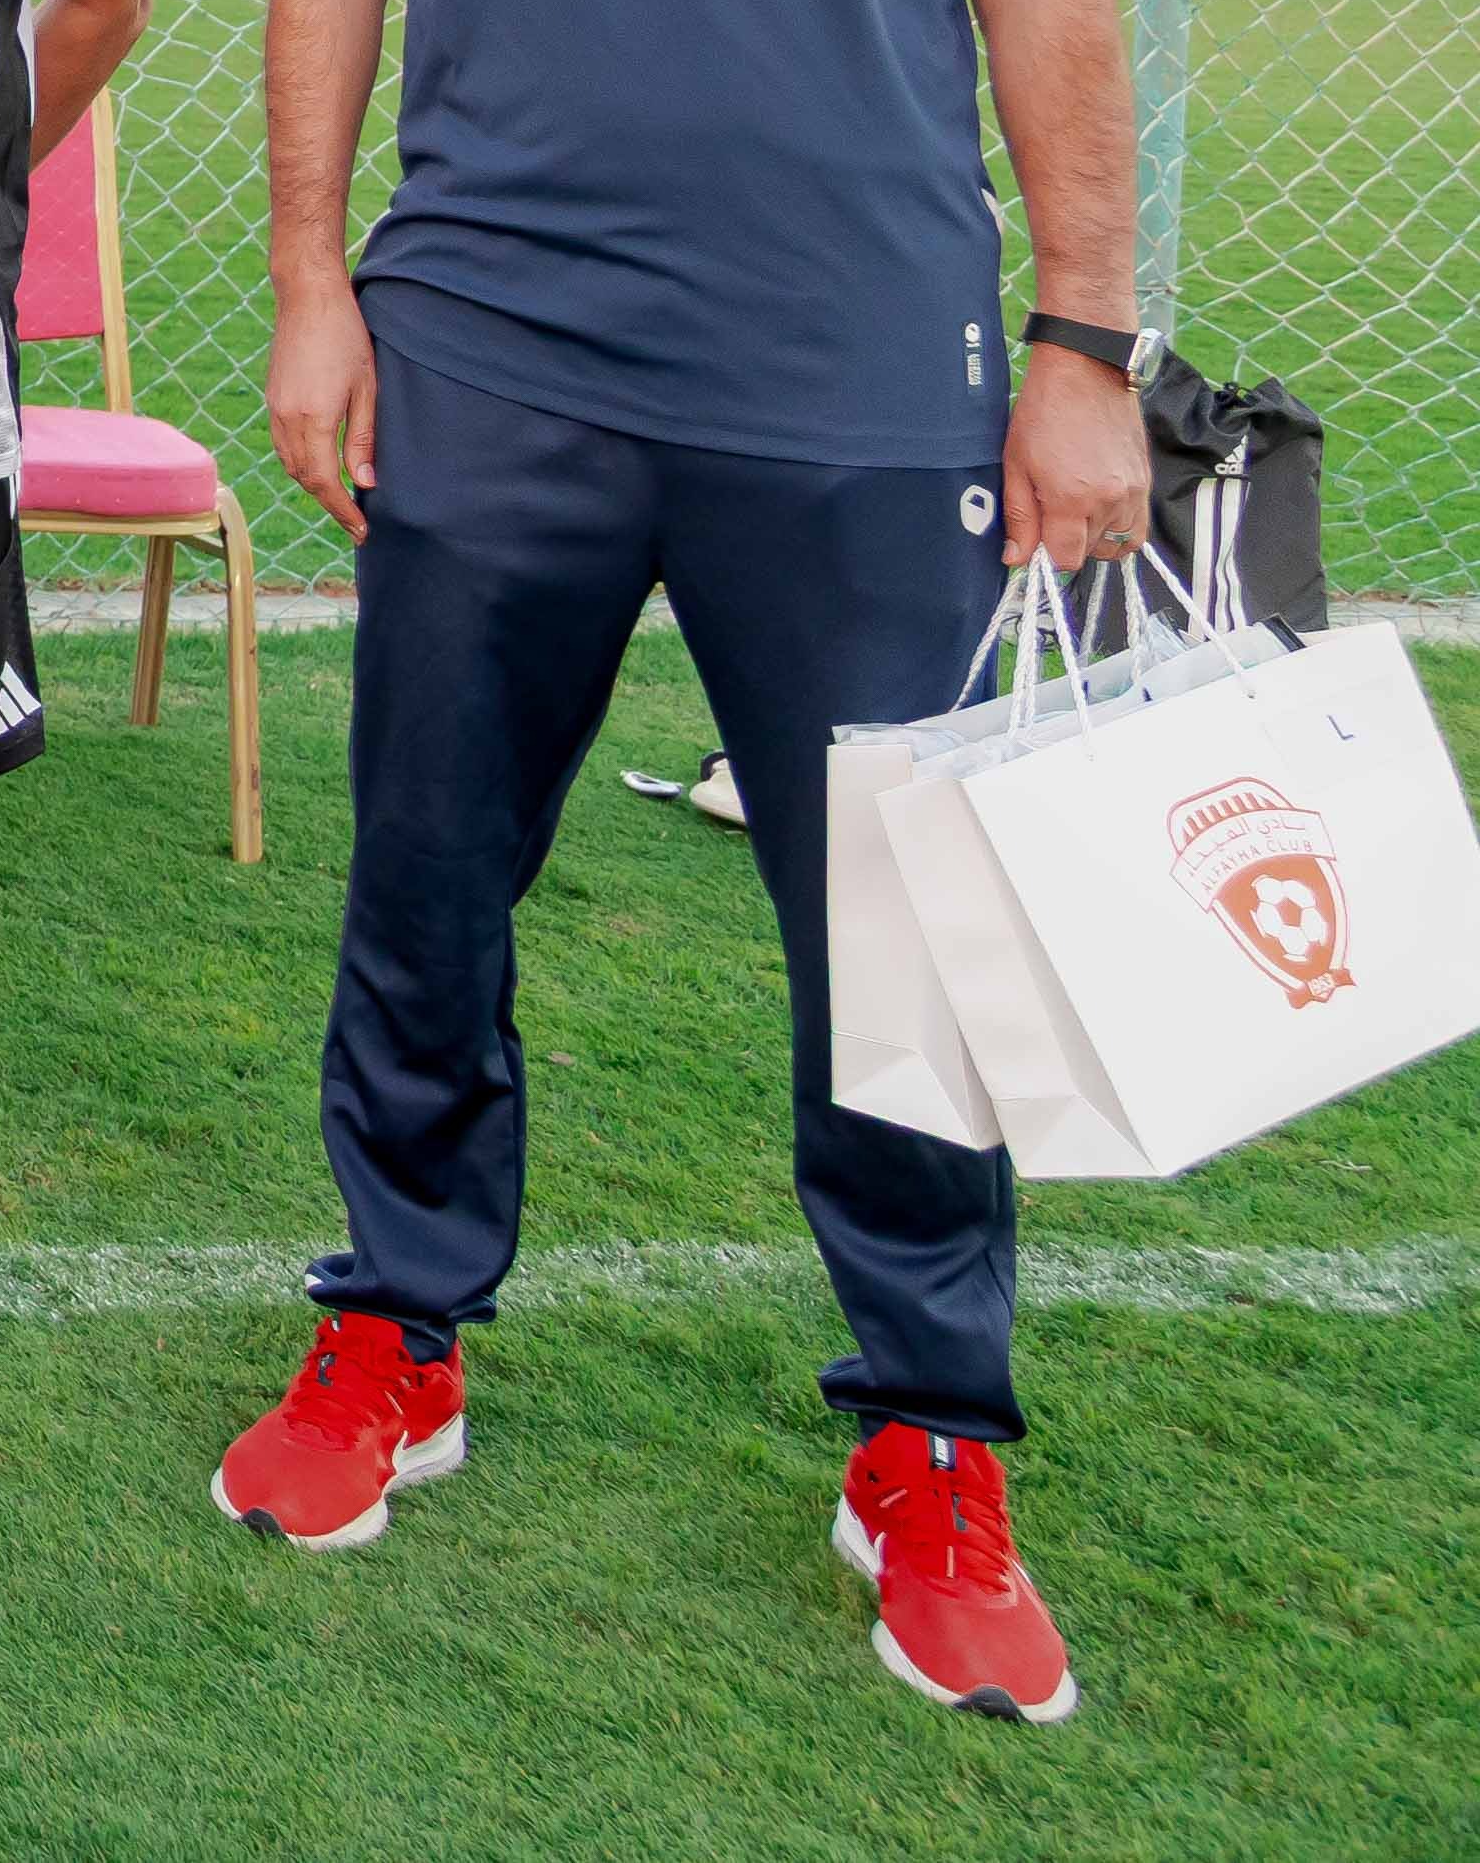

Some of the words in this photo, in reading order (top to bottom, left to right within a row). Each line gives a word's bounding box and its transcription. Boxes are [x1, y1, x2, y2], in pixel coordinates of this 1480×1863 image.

[1326, 714, 1355, 740] L
[1201, 844, 1261, 893] ALFAYHA
[1267, 838, 1313, 853] CLUB
